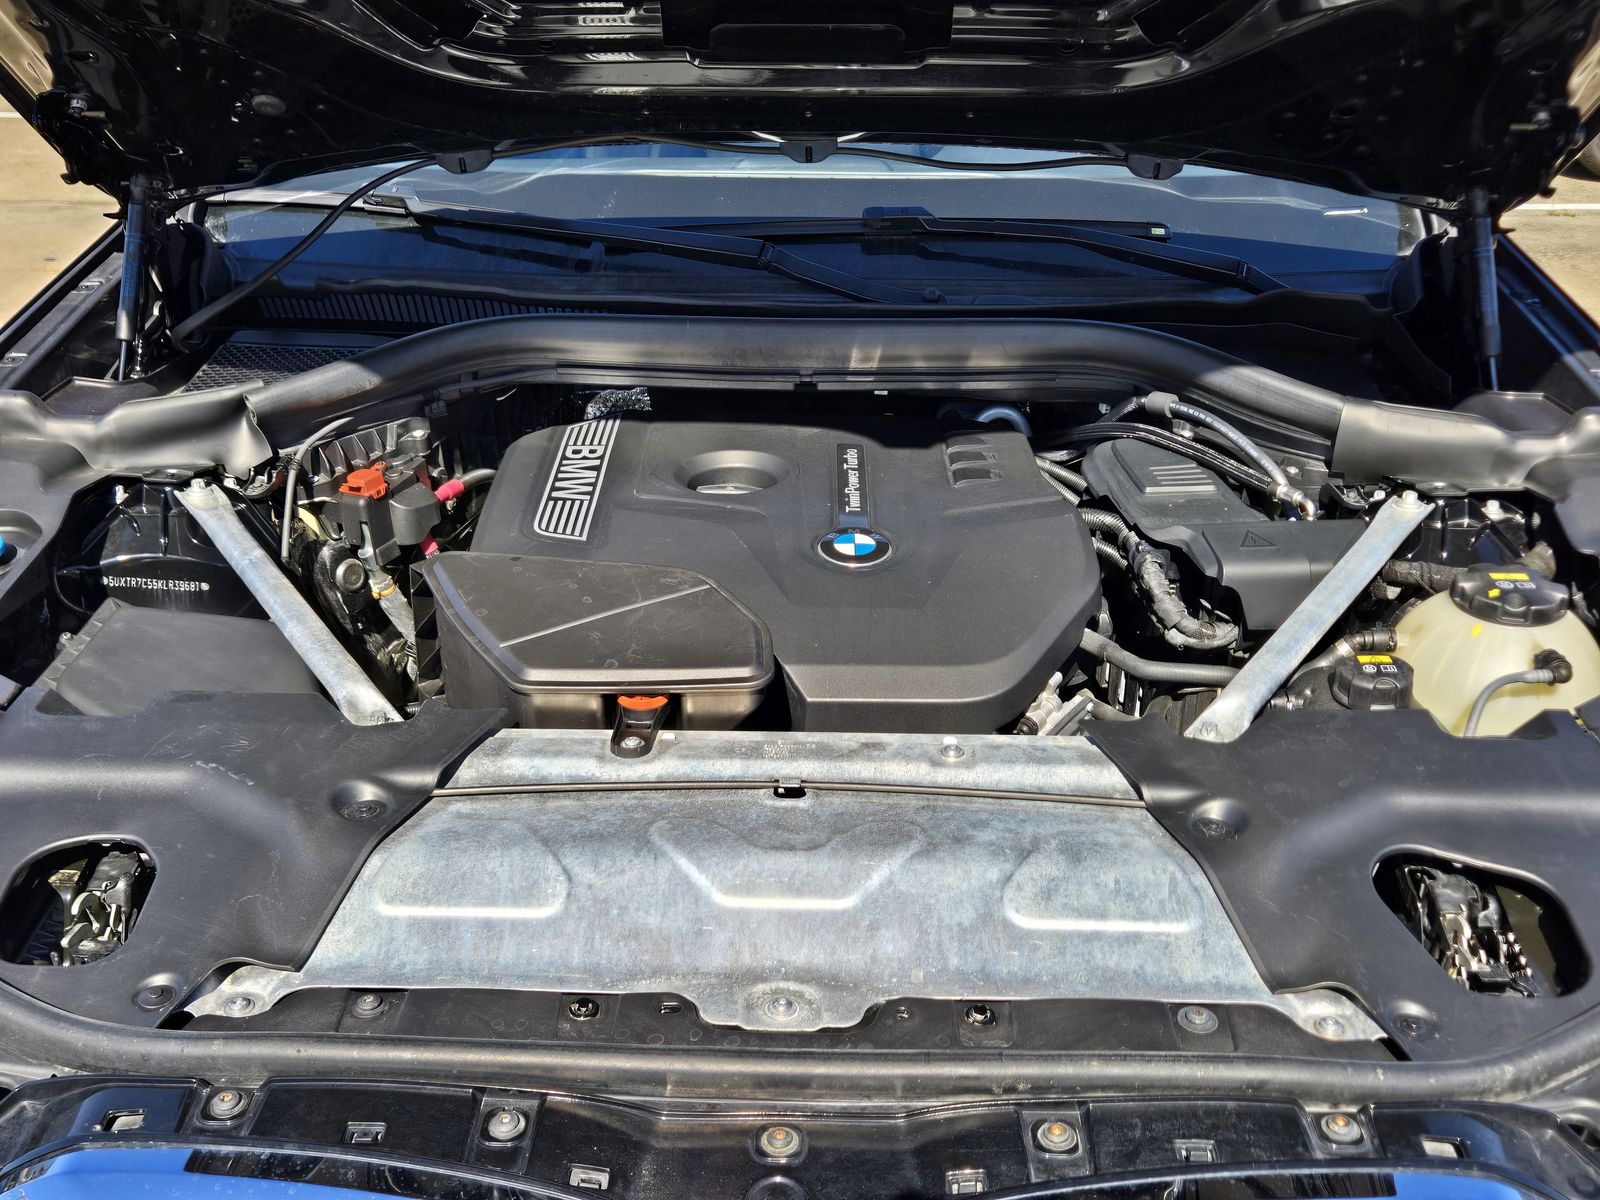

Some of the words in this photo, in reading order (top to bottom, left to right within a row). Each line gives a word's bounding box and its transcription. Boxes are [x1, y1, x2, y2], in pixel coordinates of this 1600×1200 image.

[551, 445, 606, 500] BMW
[843, 448, 859, 470] Turbo
[845, 469, 861, 513] TwinPower
[108, 576, 200, 591] 5UXTR7C55KLR39681
